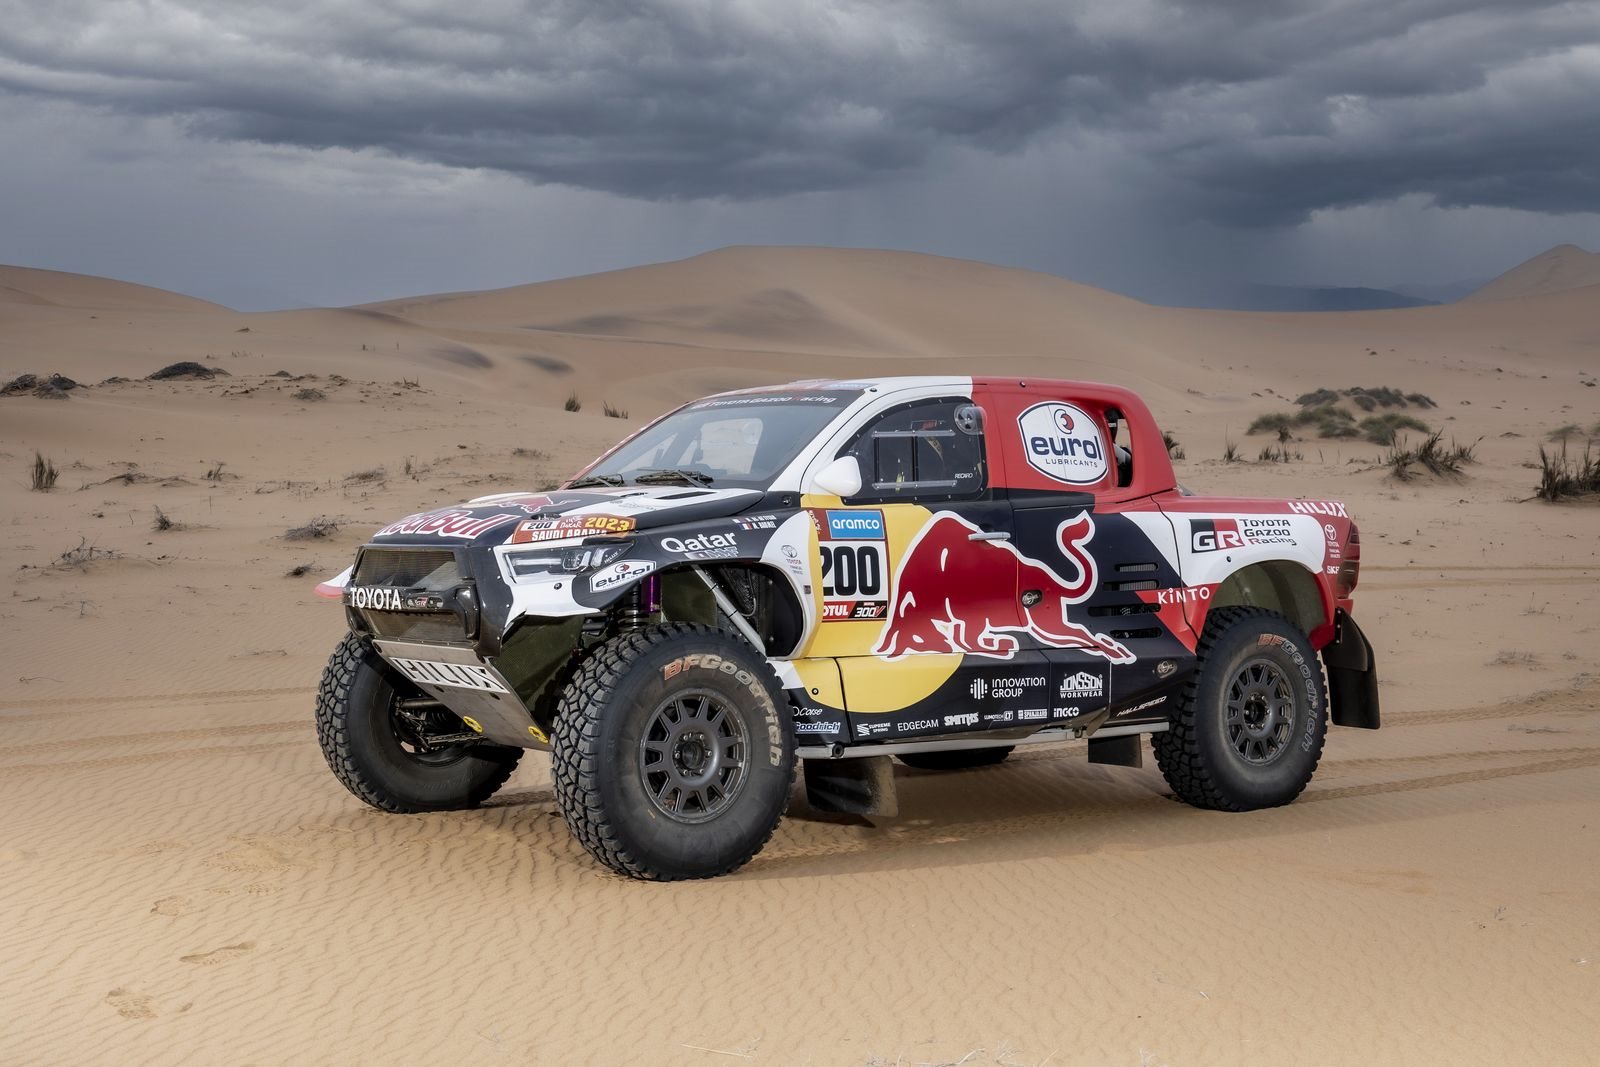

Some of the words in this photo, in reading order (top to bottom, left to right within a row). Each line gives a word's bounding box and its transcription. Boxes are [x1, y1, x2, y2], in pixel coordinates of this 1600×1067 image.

[1031, 436, 1102, 461] eurol
[1046, 459, 1097, 468] LUBRICANTS
[1288, 502, 1349, 518] HILUX
[527, 521, 552, 529] 200
[585, 517, 630, 531] 2023
[833, 520, 879, 529] aramco
[1239, 519, 1291, 527] TOYOTA
[532, 529, 563, 541] SAUDI
[566, 529, 607, 537] ARA
[1244, 529, 1291, 537] GAZOO
[661, 533, 737, 553] Qatar
[1193, 530, 1243, 552] GR
[1248, 537, 1297, 546] Racing
[596, 565, 650, 587] eurol
[350, 587, 402, 609] TOYOTA
[823, 605, 848, 616] OTUL
[854, 605, 886, 617] 300V
[992, 677, 1046, 688] INNOVATION
[1060, 672, 1103, 690] JONSSON
[992, 689, 1023, 698] GROUP
[1060, 690, 1103, 699] WORKWEAR
[898, 719, 939, 732] EDGECAM
[944, 713, 979, 727] SMITHS
